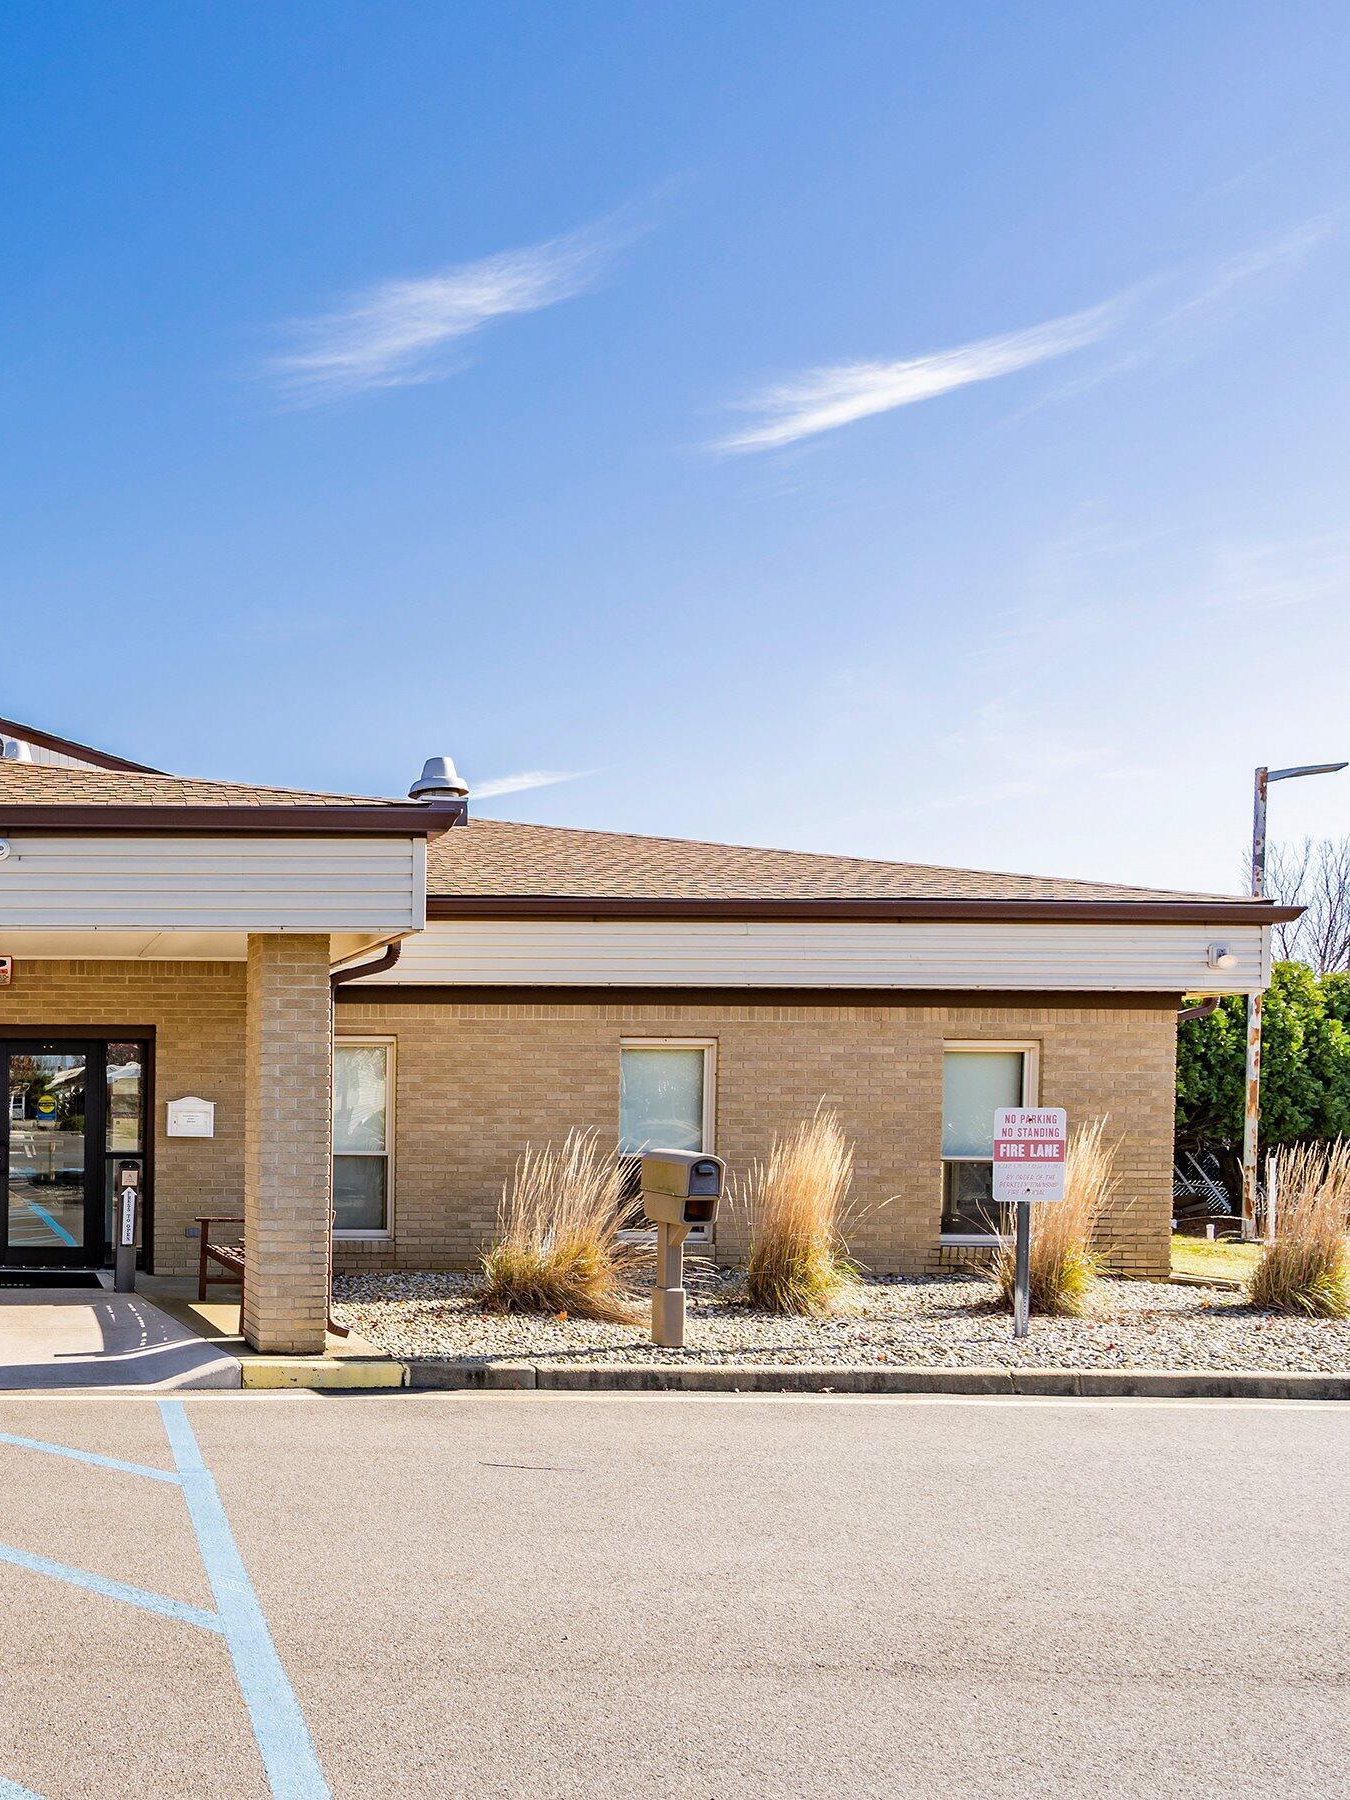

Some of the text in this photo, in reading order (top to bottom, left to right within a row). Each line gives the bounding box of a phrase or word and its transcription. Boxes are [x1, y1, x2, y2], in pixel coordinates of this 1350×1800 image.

[1004, 1114, 1058, 1124] NO PARKING
[1002, 1128, 1060, 1138] NO STANDING
[1000, 1144, 1060, 1158] FIRE LANE
[126, 1214, 131, 1222] TO
